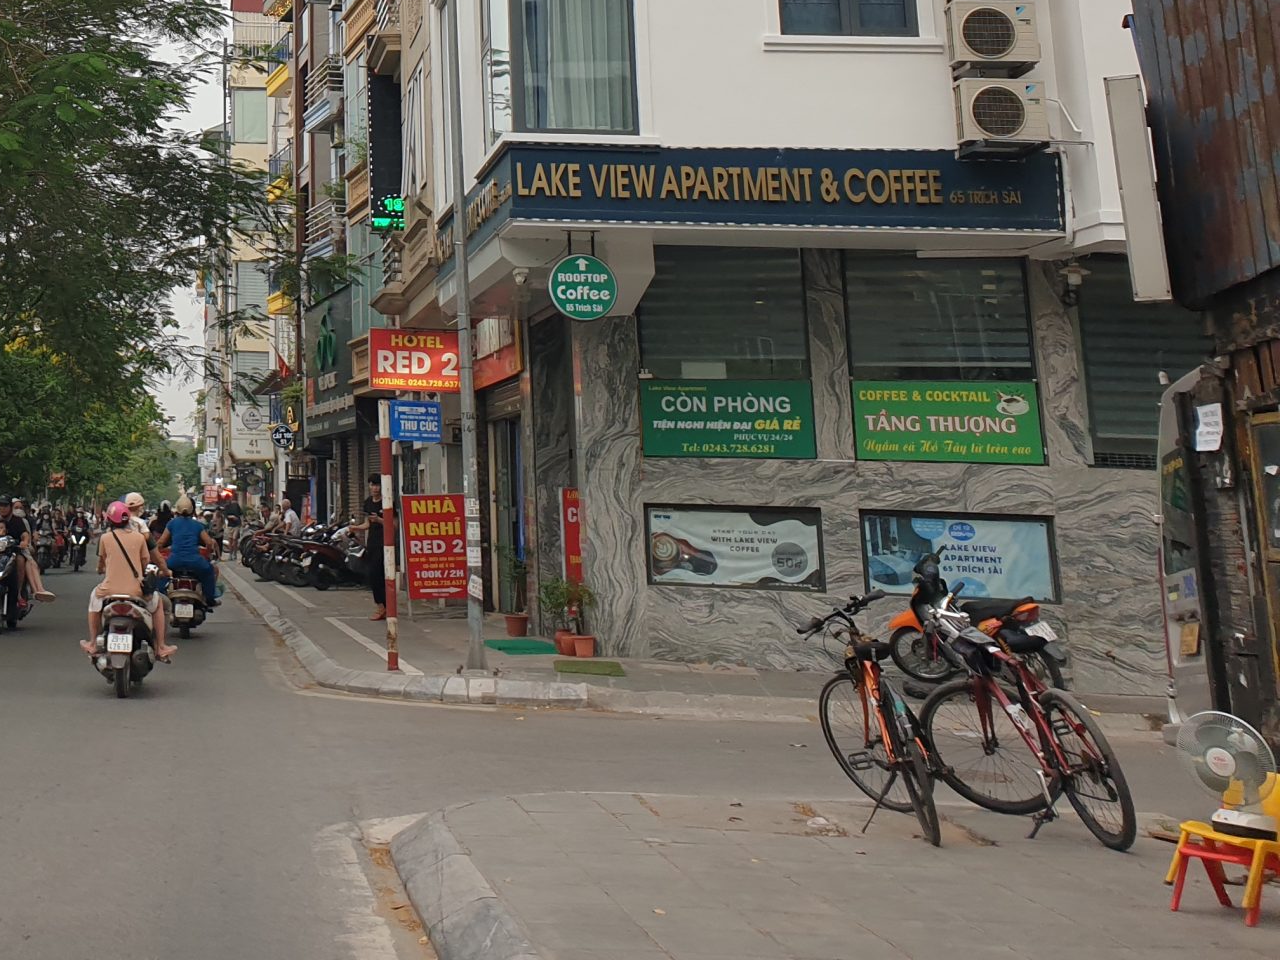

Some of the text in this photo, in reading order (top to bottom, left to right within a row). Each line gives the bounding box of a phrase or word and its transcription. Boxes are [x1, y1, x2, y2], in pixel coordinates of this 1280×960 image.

[516, 162, 582, 197] LAKE
[588, 164, 656, 198] VIEW
[659, 166, 813, 202] APARTMENT
[820, 168, 840, 203] &
[843, 168, 944, 204] COFFEE
[949, 191, 965, 204] 65
[557, 273, 608, 283] ROOFTOP
[557, 285, 611, 300] Coffee
[390, 334, 444, 349] HOTEL
[377, 349, 458, 376] RED 2
[372, 377, 407, 386] HOTLINE:
[661, 392, 791, 413] CÒN PHÒNG
[859, 390, 991, 402] COFFEE & COCKTAIL
[400, 420, 417, 431] THU
[676, 420, 704, 430] NGHI
[754, 417, 780, 430] GIÁ
[926, 415, 1017, 437] THƯỢNG
[681, 442, 701, 453] Tel:
[410, 497, 456, 514] NHÀ
[409, 516, 461, 536] NGHỈ
[409, 539, 464, 554] RED 2
[729, 545, 760, 553] COFFEE
[944, 543, 997, 553] LAKE VIEW
[943, 554, 1002, 564] APARTMENT
